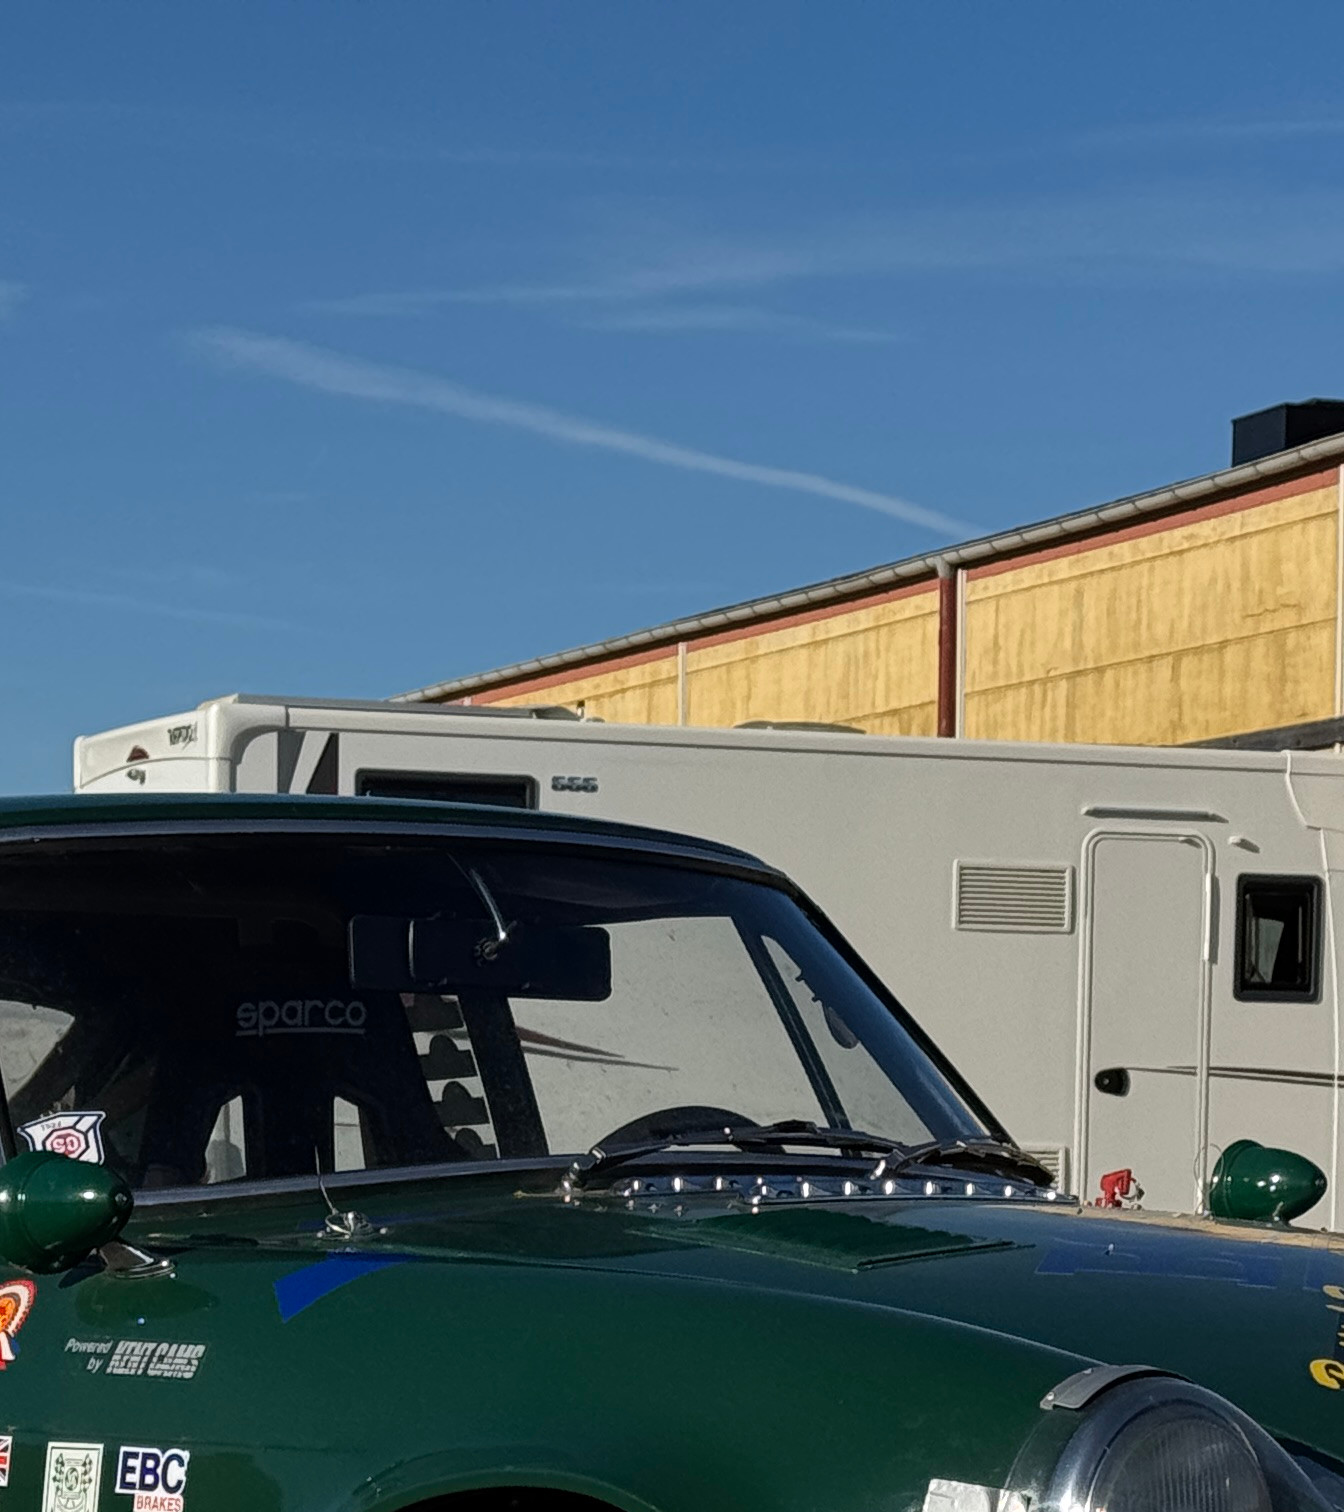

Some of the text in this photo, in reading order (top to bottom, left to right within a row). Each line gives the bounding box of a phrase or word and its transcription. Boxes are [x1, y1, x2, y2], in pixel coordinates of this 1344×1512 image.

[237, 1000, 366, 1036] sparco
[64, 1337, 113, 1354] Powered
[87, 1356, 104, 1374] by
[120, 1450, 186, 1494] EBC
[136, 1496, 183, 1512] BRAKES
